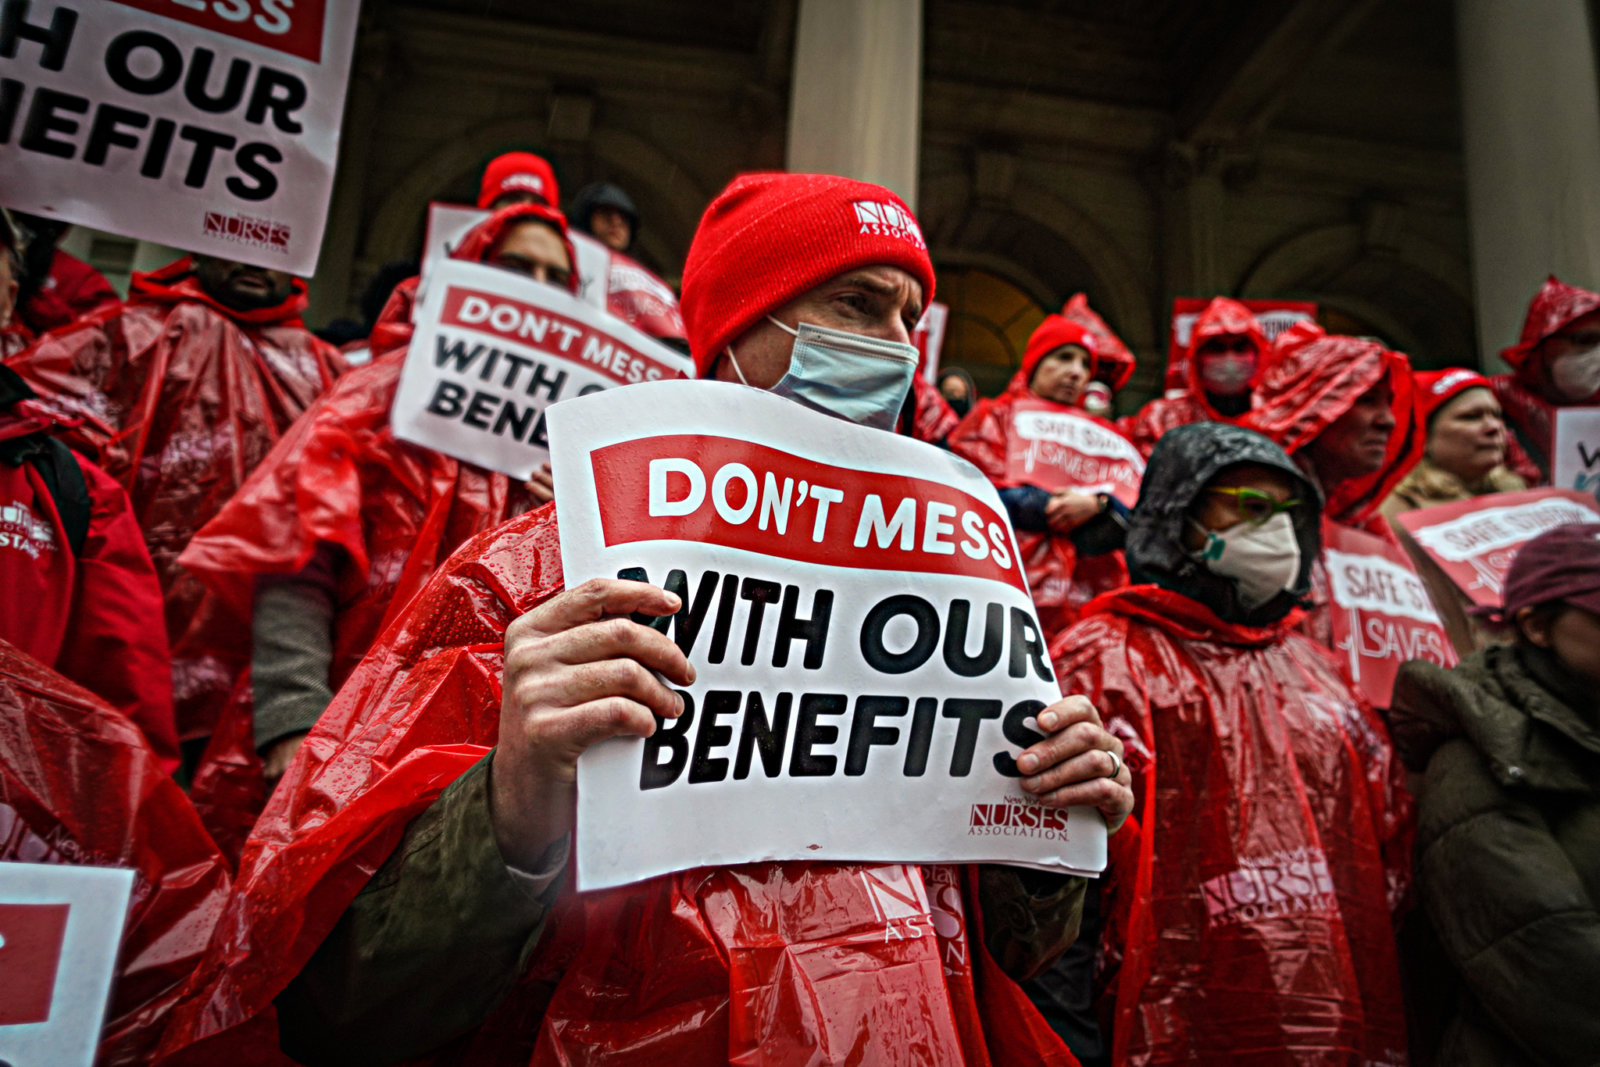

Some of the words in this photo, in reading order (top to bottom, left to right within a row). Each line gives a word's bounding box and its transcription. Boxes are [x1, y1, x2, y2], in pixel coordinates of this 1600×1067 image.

[104, 29, 308, 134] OUR
[203, 211, 291, 247] NURSES
[458, 296, 582, 352] DON'T
[434, 335, 568, 402] WITH
[648, 457, 844, 543] DON'T
[853, 493, 1012, 570] MESS
[1344, 564, 1403, 606] SAFE
[617, 567, 835, 671] WITH
[860, 594, 1054, 683] OUR
[1365, 617, 1446, 669] SAVES
[639, 689, 1050, 791] BENEFITS
[967, 826, 1069, 842] ASSOCIATION
[969, 804, 1069, 831] NURSES
